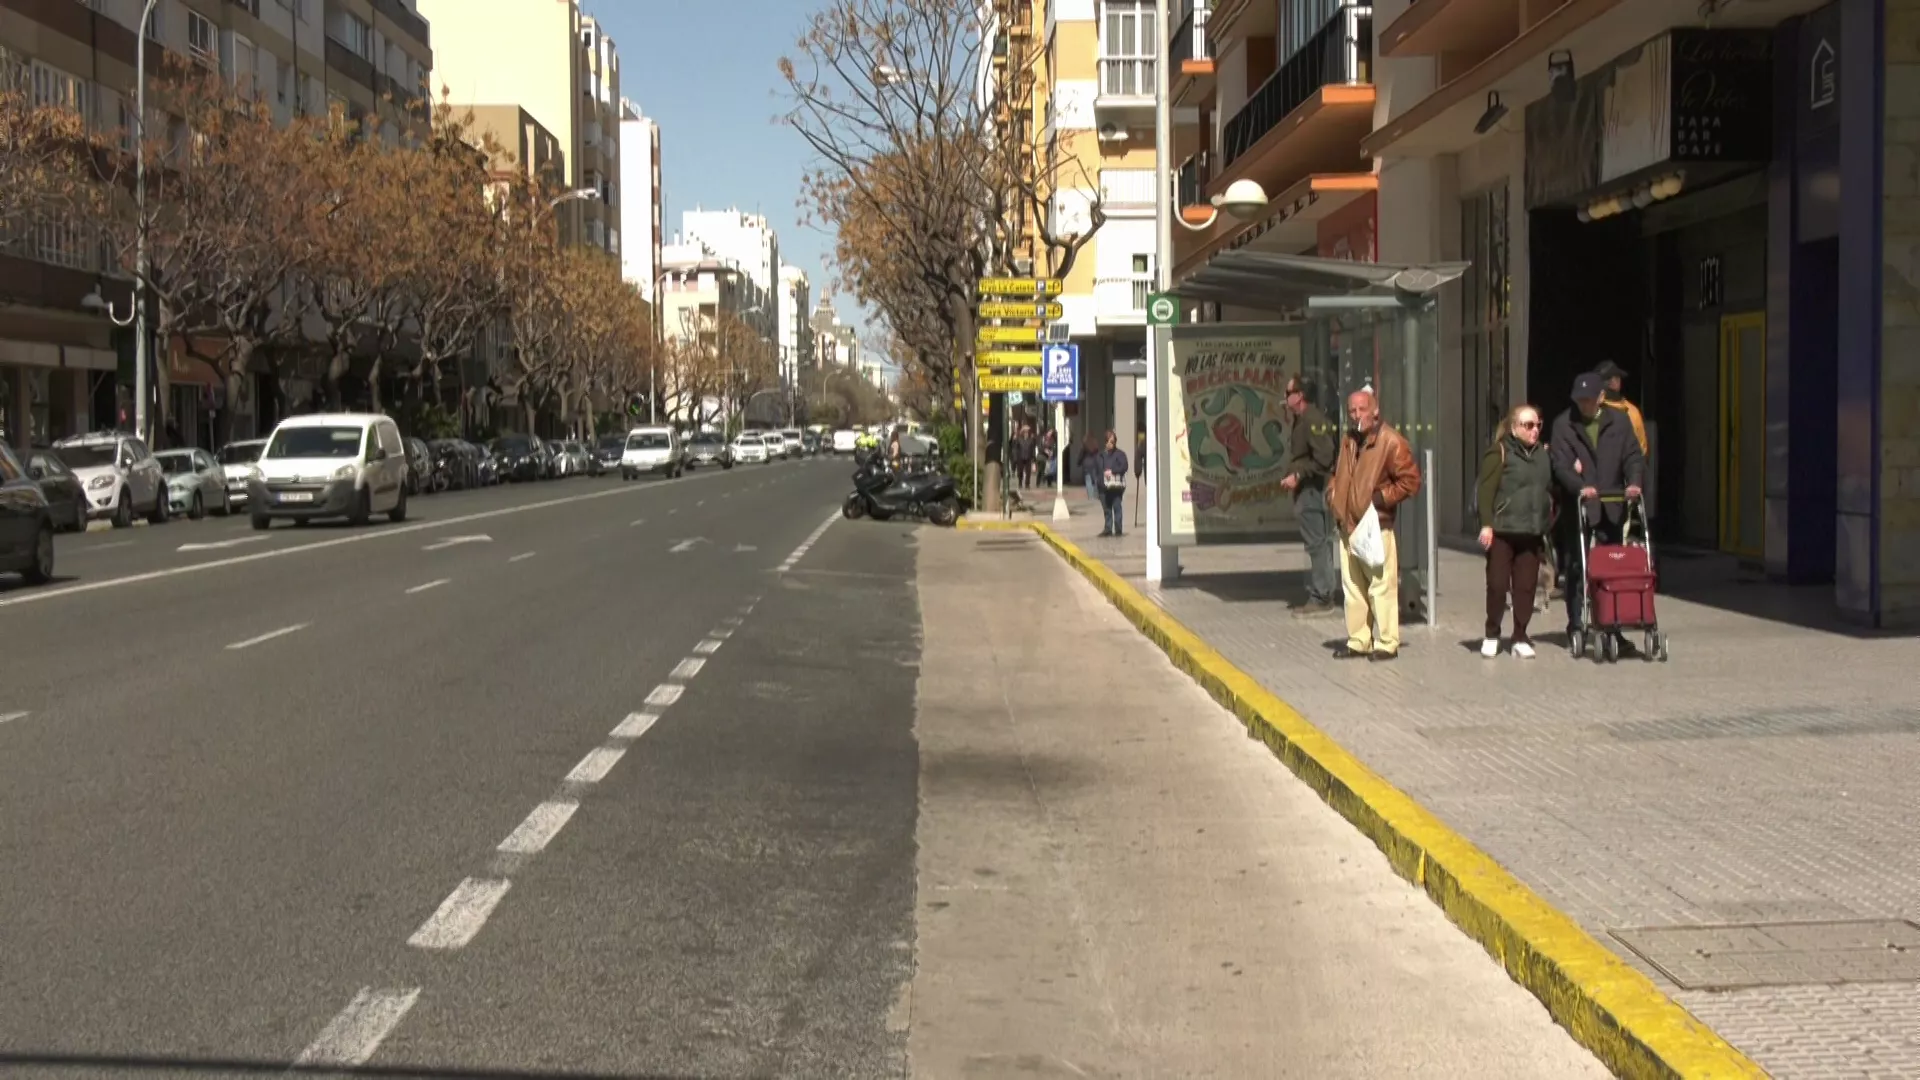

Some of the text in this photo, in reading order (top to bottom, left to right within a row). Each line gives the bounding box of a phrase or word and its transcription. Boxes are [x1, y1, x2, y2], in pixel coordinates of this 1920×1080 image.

[1678, 116, 1721, 128] TAPA
[1678, 130, 1711, 142] BAR
[1184, 351, 1286, 376] NO LAS TIRES AL SUELO
